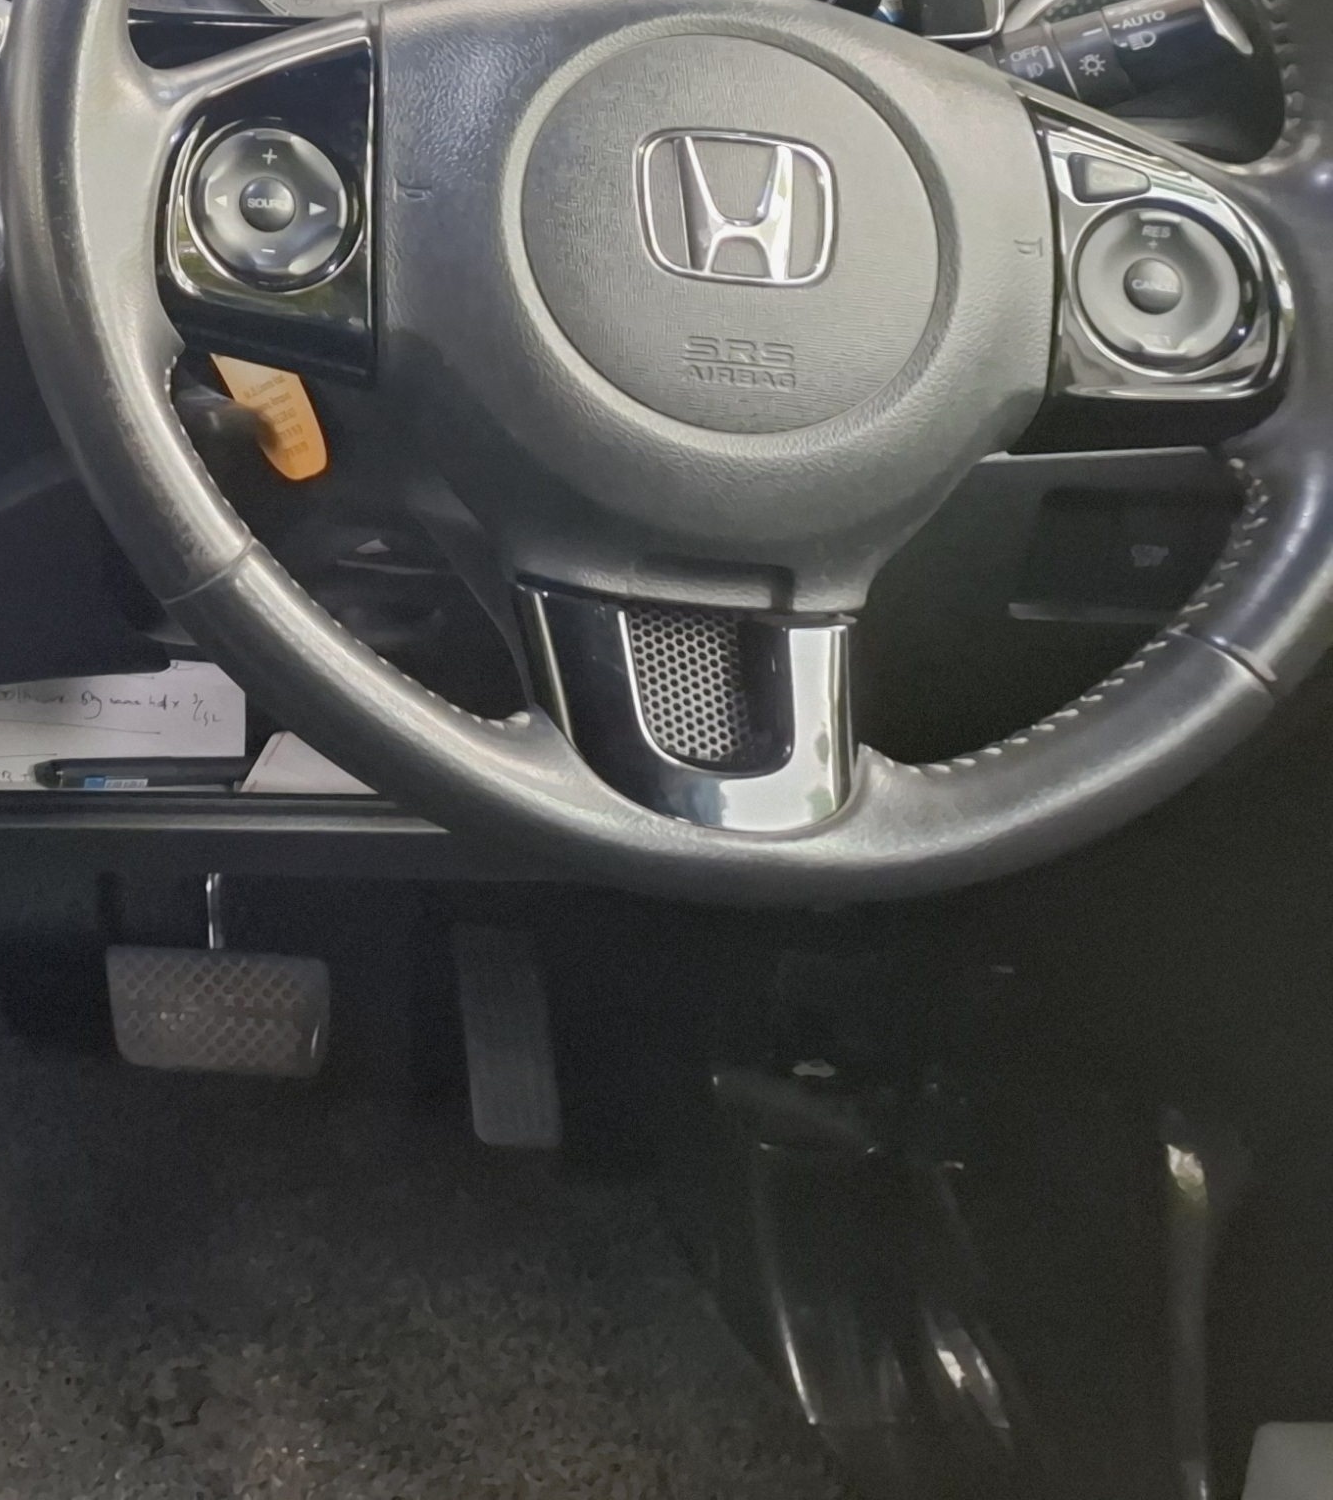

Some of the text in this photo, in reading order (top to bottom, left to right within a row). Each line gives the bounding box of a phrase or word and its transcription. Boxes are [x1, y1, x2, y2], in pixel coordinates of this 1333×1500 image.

[1122, 11, 1166, 30] AUTO
[1010, 46, 1042, 62] OFF
[685, 336, 795, 365] SRS
[686, 364, 797, 392] AIRBAG
